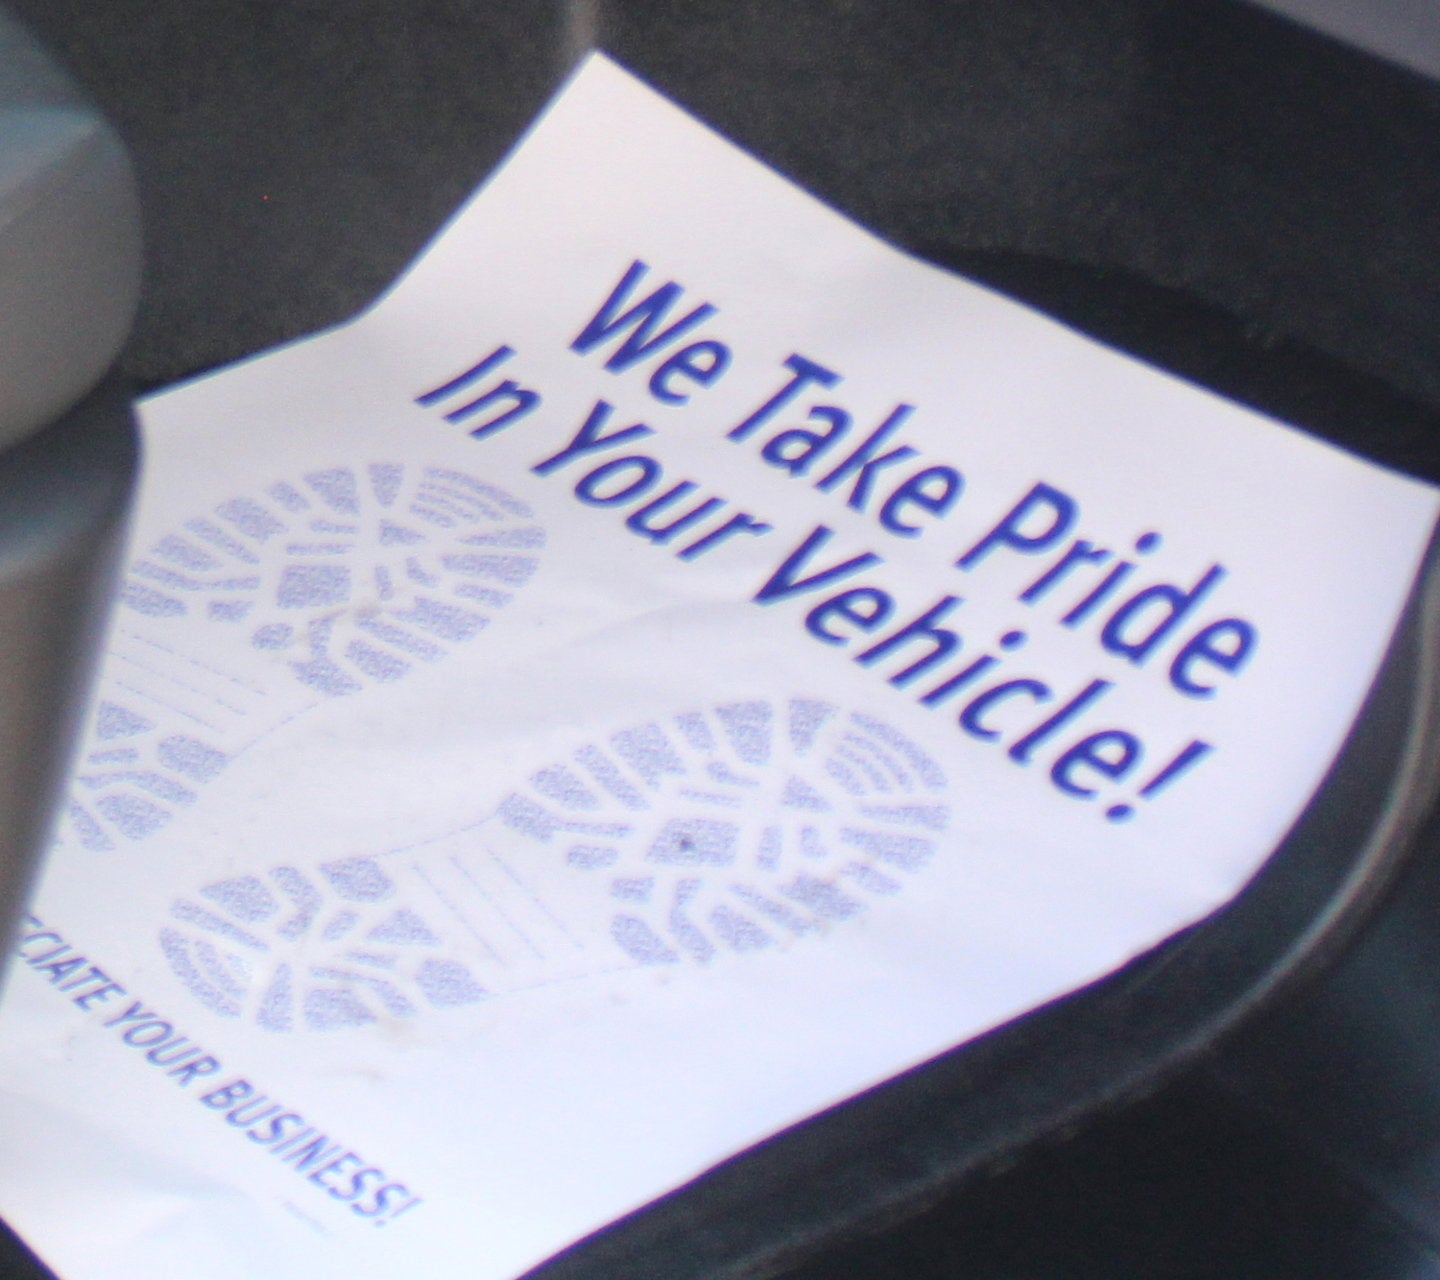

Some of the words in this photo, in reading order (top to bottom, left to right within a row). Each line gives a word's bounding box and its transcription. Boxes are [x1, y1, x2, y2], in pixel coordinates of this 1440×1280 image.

[414, 344, 543, 441] In
[529, 399, 775, 563] Your
[750, 523, 1217, 825] Vehicle!
[568, 258, 733, 407] We
[725, 352, 967, 540] Take
[953, 480, 1261, 701] Pride
[103, 1000, 221, 1087] YOUR
[198, 1078, 424, 1227] BUSINESS!
